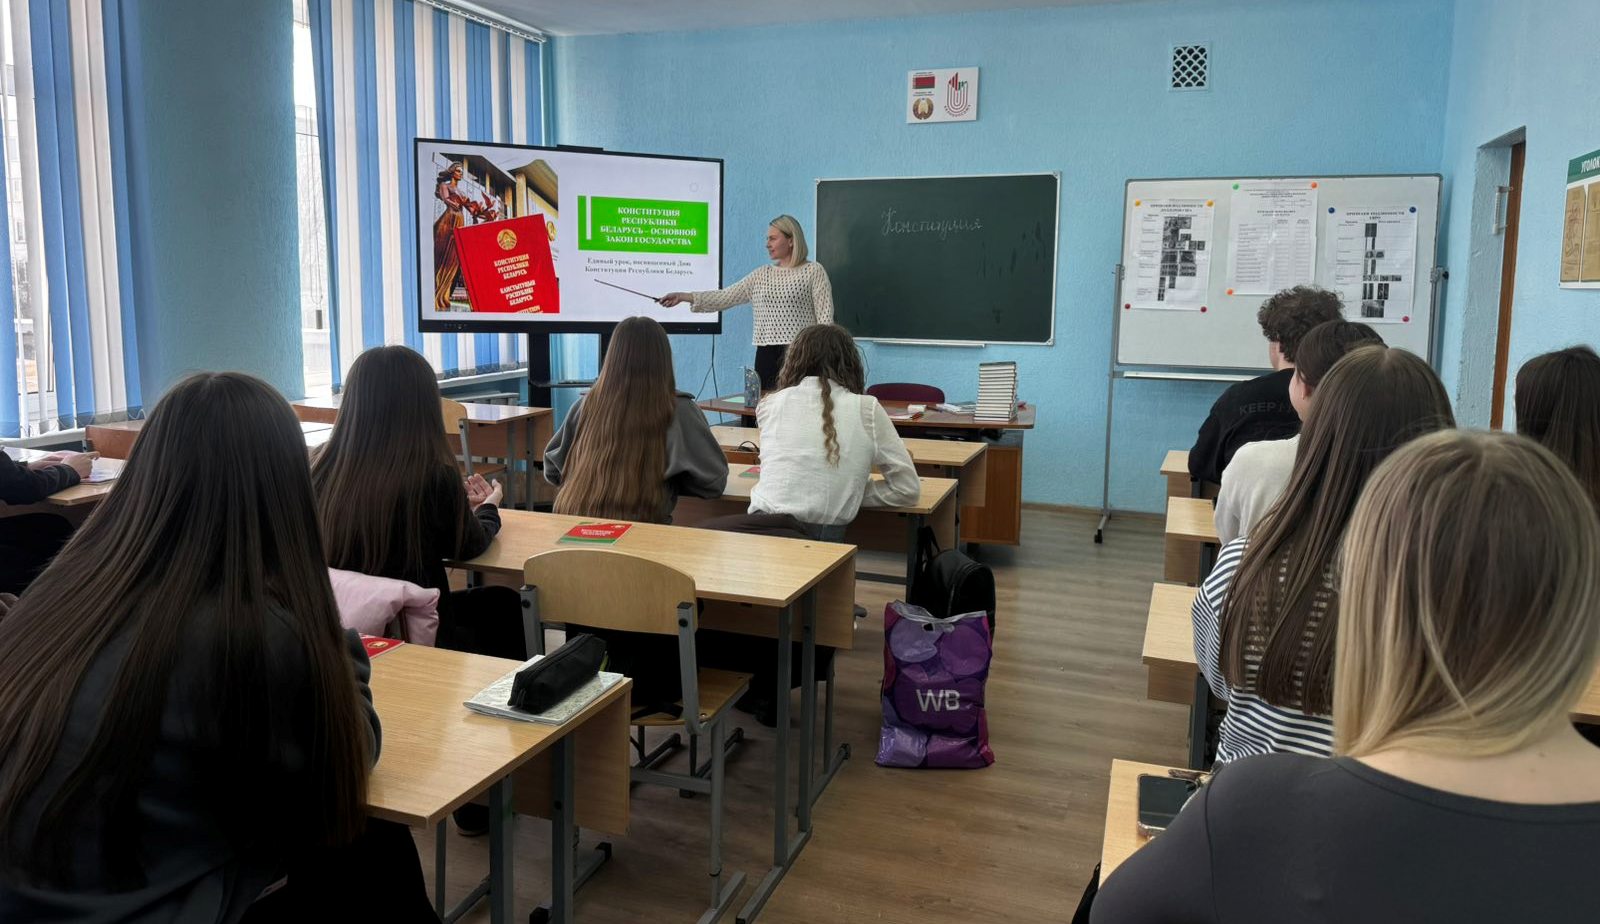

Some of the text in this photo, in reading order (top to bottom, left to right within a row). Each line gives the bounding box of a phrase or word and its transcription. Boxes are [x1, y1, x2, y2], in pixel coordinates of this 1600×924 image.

[618, 207, 680, 217] КОНСТИТУЦИЯ
[621, 217, 677, 226] РЕСПУБЛИКИ
[881, 207, 983, 240] Конституция
[600, 225, 643, 234] БЕЛАРУСЬ
[650, 227, 697, 237] ОСНОВНОЙ
[606, 235, 692, 245] ЗАКОН ГОСУДАРСТВА
[1239, 402, 1277, 416] KEEP
[916, 689, 960, 712] WB
